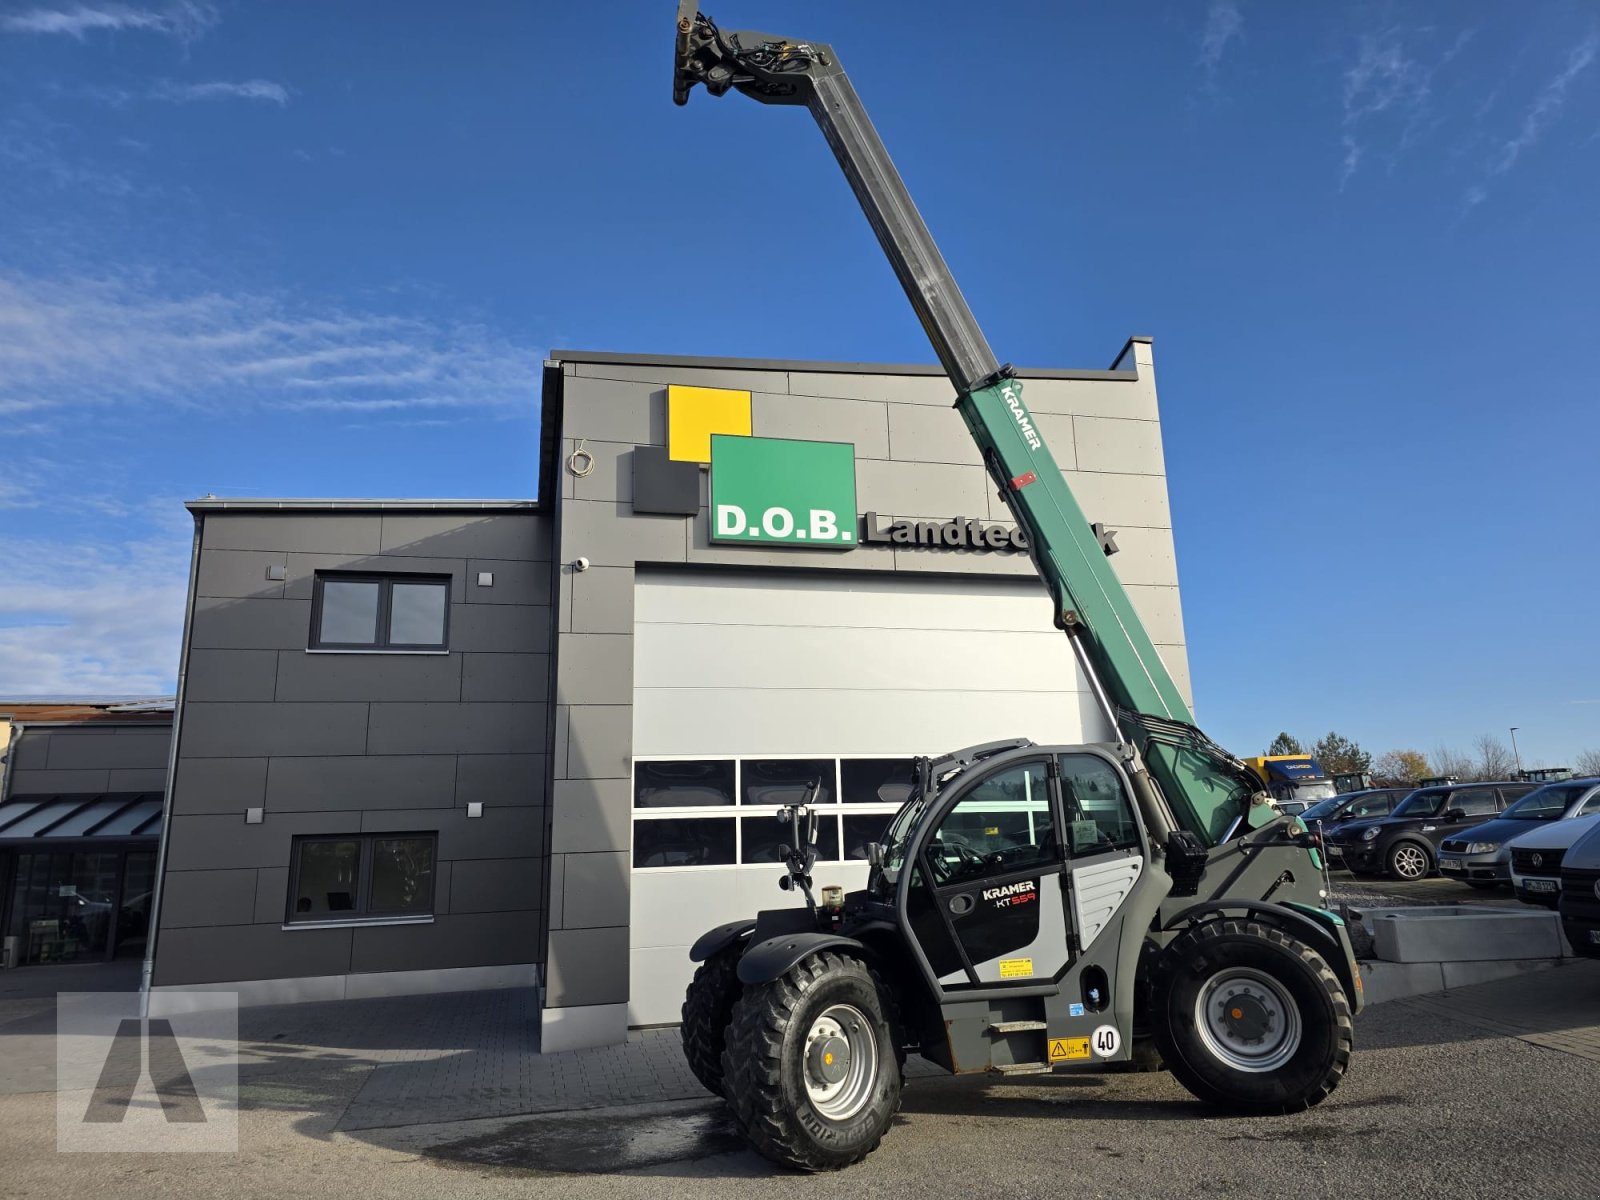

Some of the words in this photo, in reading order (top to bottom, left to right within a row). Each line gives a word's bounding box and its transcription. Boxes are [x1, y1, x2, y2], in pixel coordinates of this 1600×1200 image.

[1001, 386, 1041, 451] KRAMER
[717, 504, 852, 541] D.O.B.
[865, 511, 1120, 554] Landteck
[982, 880, 1036, 901] KRAMER
[1098, 1031, 1114, 1051] 40
